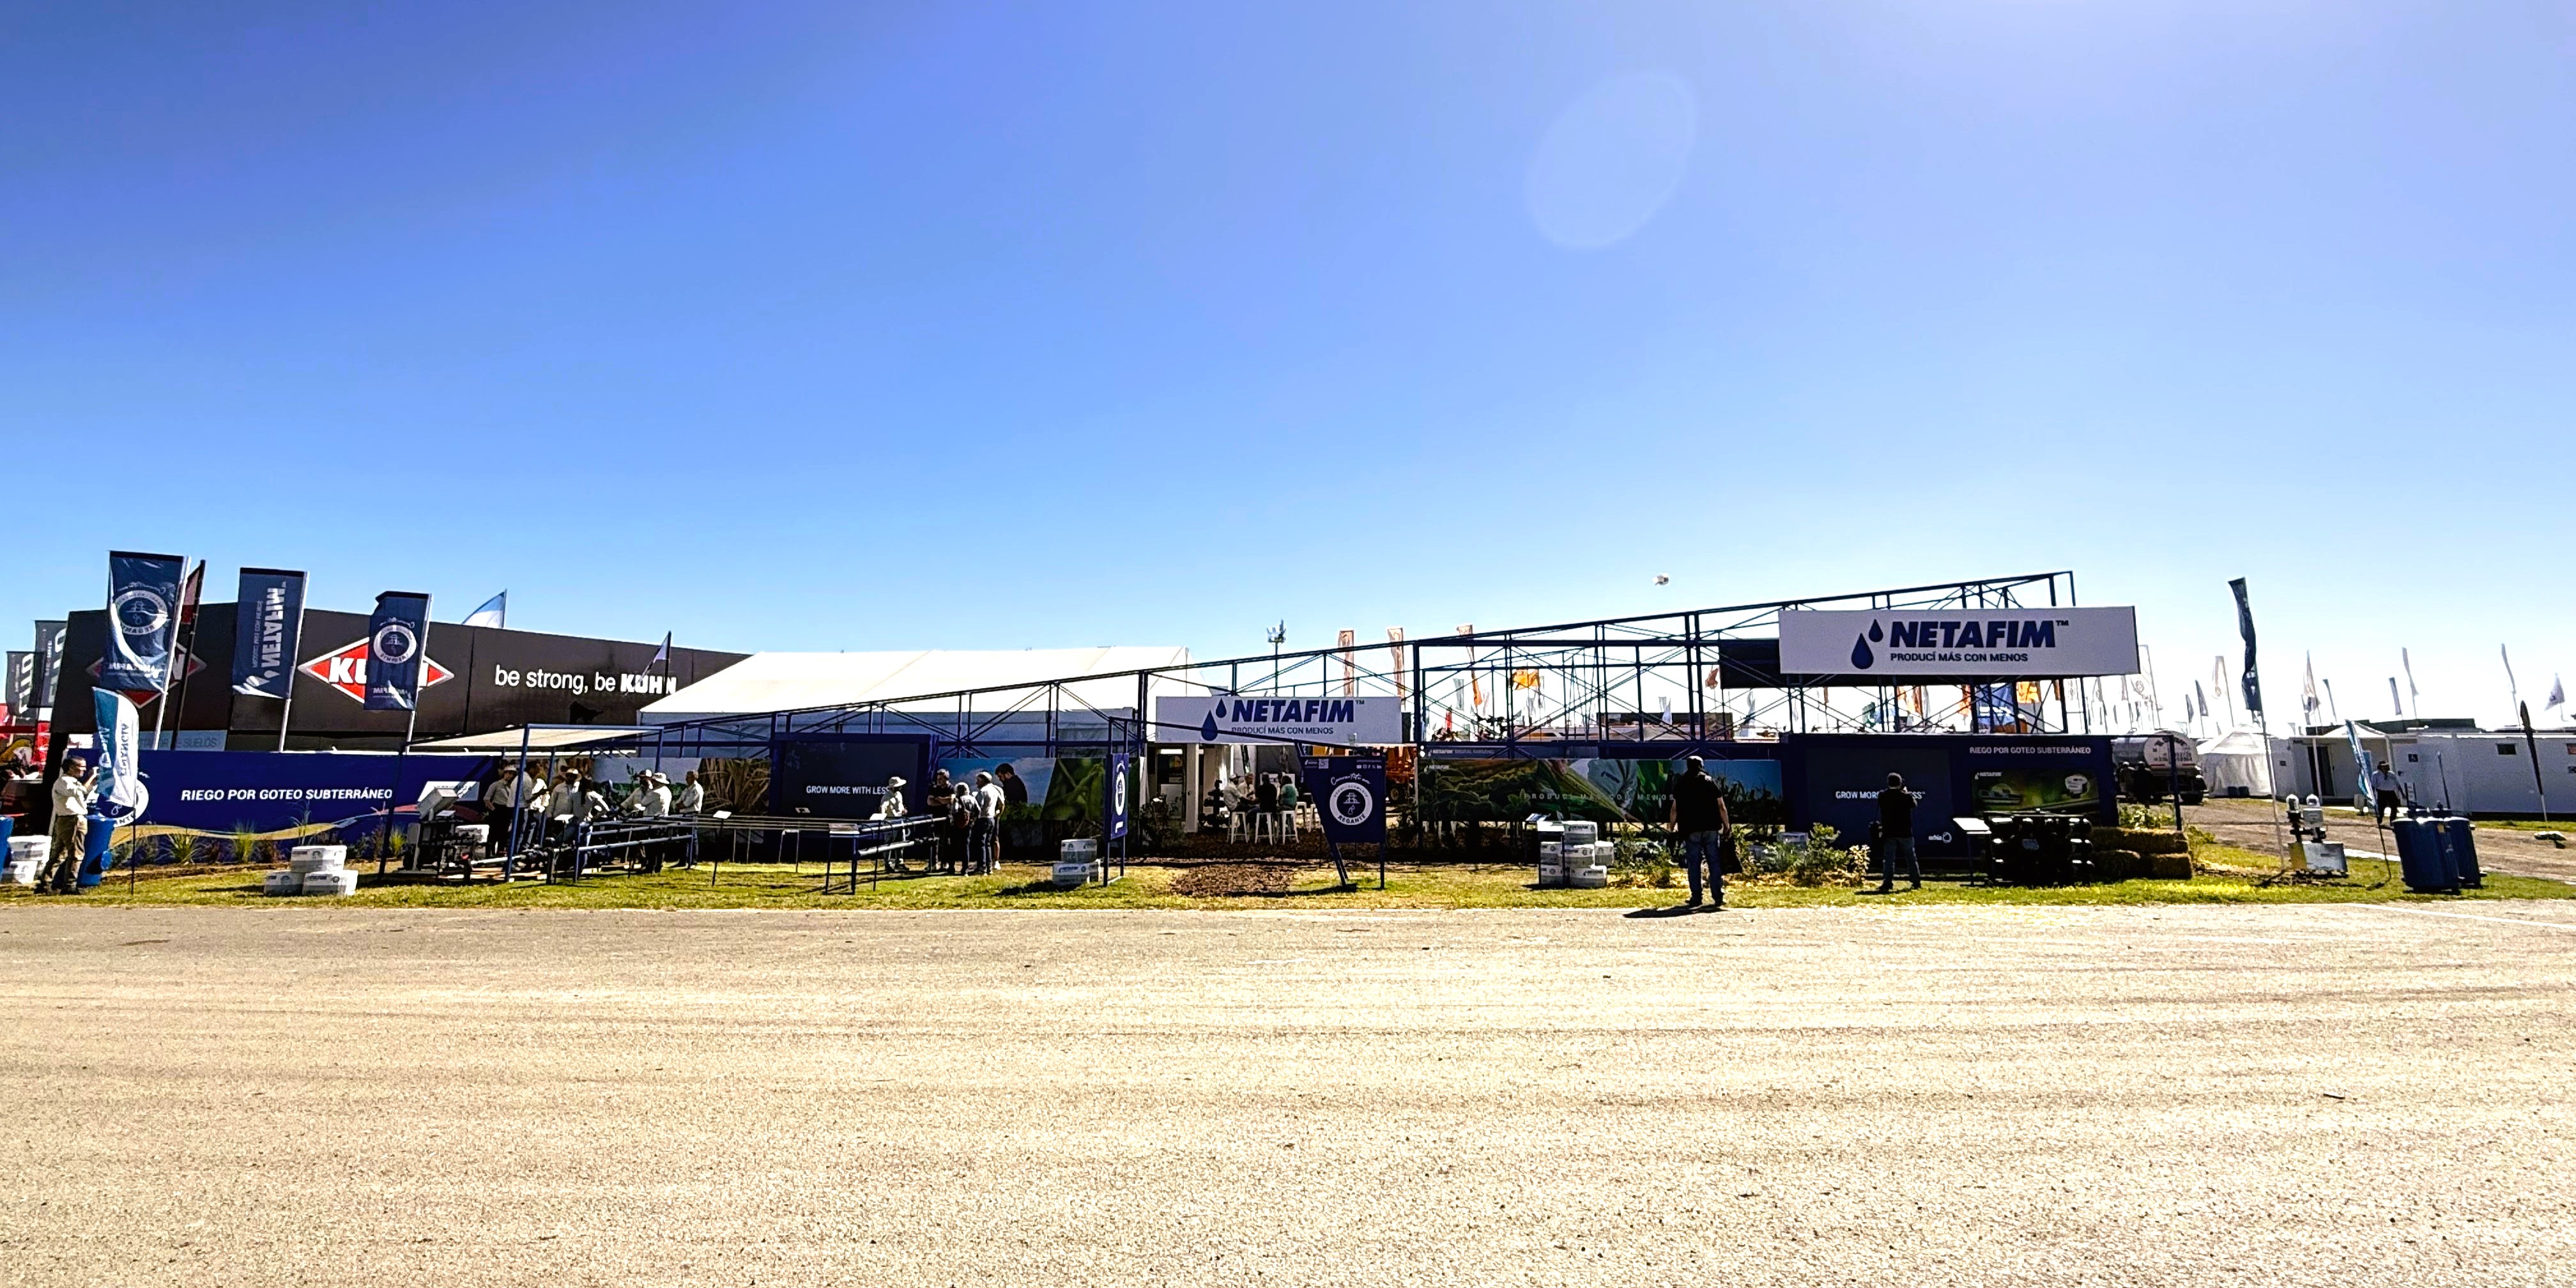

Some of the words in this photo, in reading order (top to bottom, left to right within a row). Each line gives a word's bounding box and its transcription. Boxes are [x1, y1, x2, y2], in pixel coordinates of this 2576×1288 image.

[1890, 651, 1936, 661] PRODUCÍ
[1938, 651, 1961, 661] MÁS
[1964, 653, 1987, 661] CON
[1989, 653, 2028, 661] MENOS
[495, 664, 520, 686] be
[526, 669, 588, 695] strong,
[595, 672, 615, 691] be
[620, 673, 677, 694] KUHN
[1268, 725, 1285, 734] MÁS
[181, 790, 224, 801] RIEGO
[227, 789, 256, 800] POR
[259, 789, 303, 800] GOTEO
[305, 787, 392, 800] SUBTERRÁNEO
[806, 785, 829, 793] GROW
[830, 786, 850, 794] MORE
[852, 786, 871, 795] WITH
